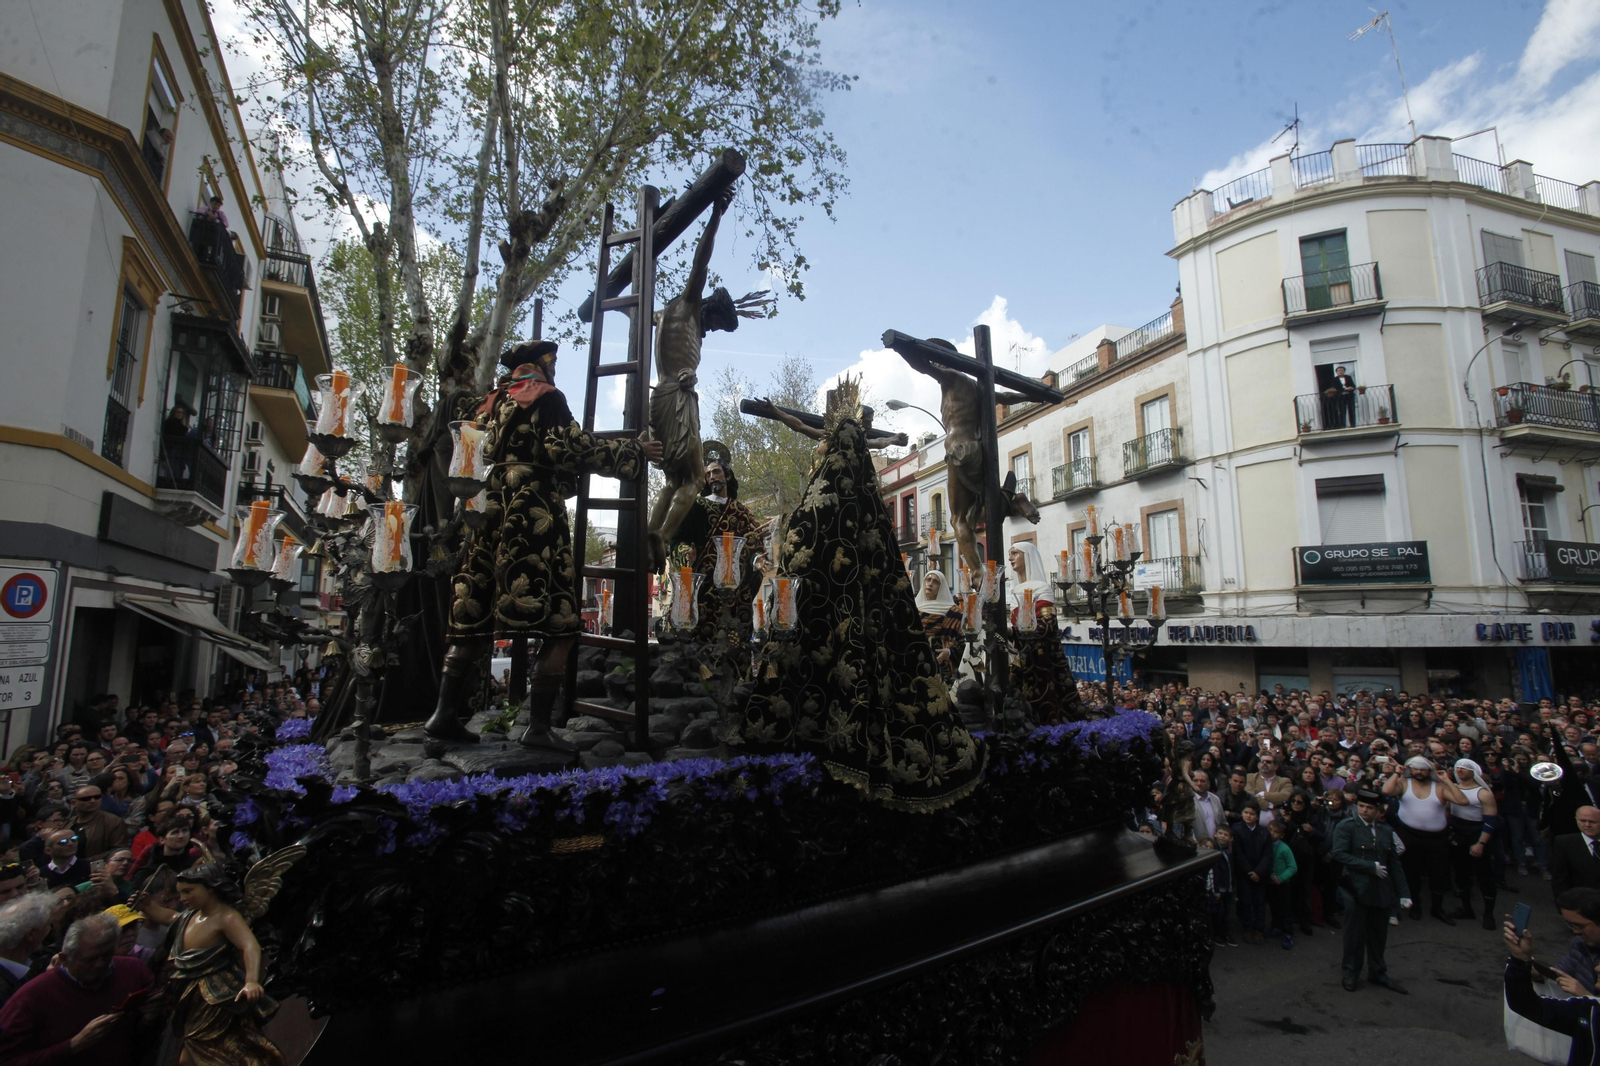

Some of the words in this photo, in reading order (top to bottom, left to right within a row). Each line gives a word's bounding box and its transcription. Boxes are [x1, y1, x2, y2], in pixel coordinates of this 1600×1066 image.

[1324, 548, 1369, 559] GRUPO
[1557, 547, 1600, 566] GRUP
[1088, 627, 1155, 642] PATEERI
[1167, 625, 1257, 642] HELADERIA
[1540, 621, 1577, 641] BAR
[18, 673, 38, 683] AZUL
[24, 691, 32, 701] 3
